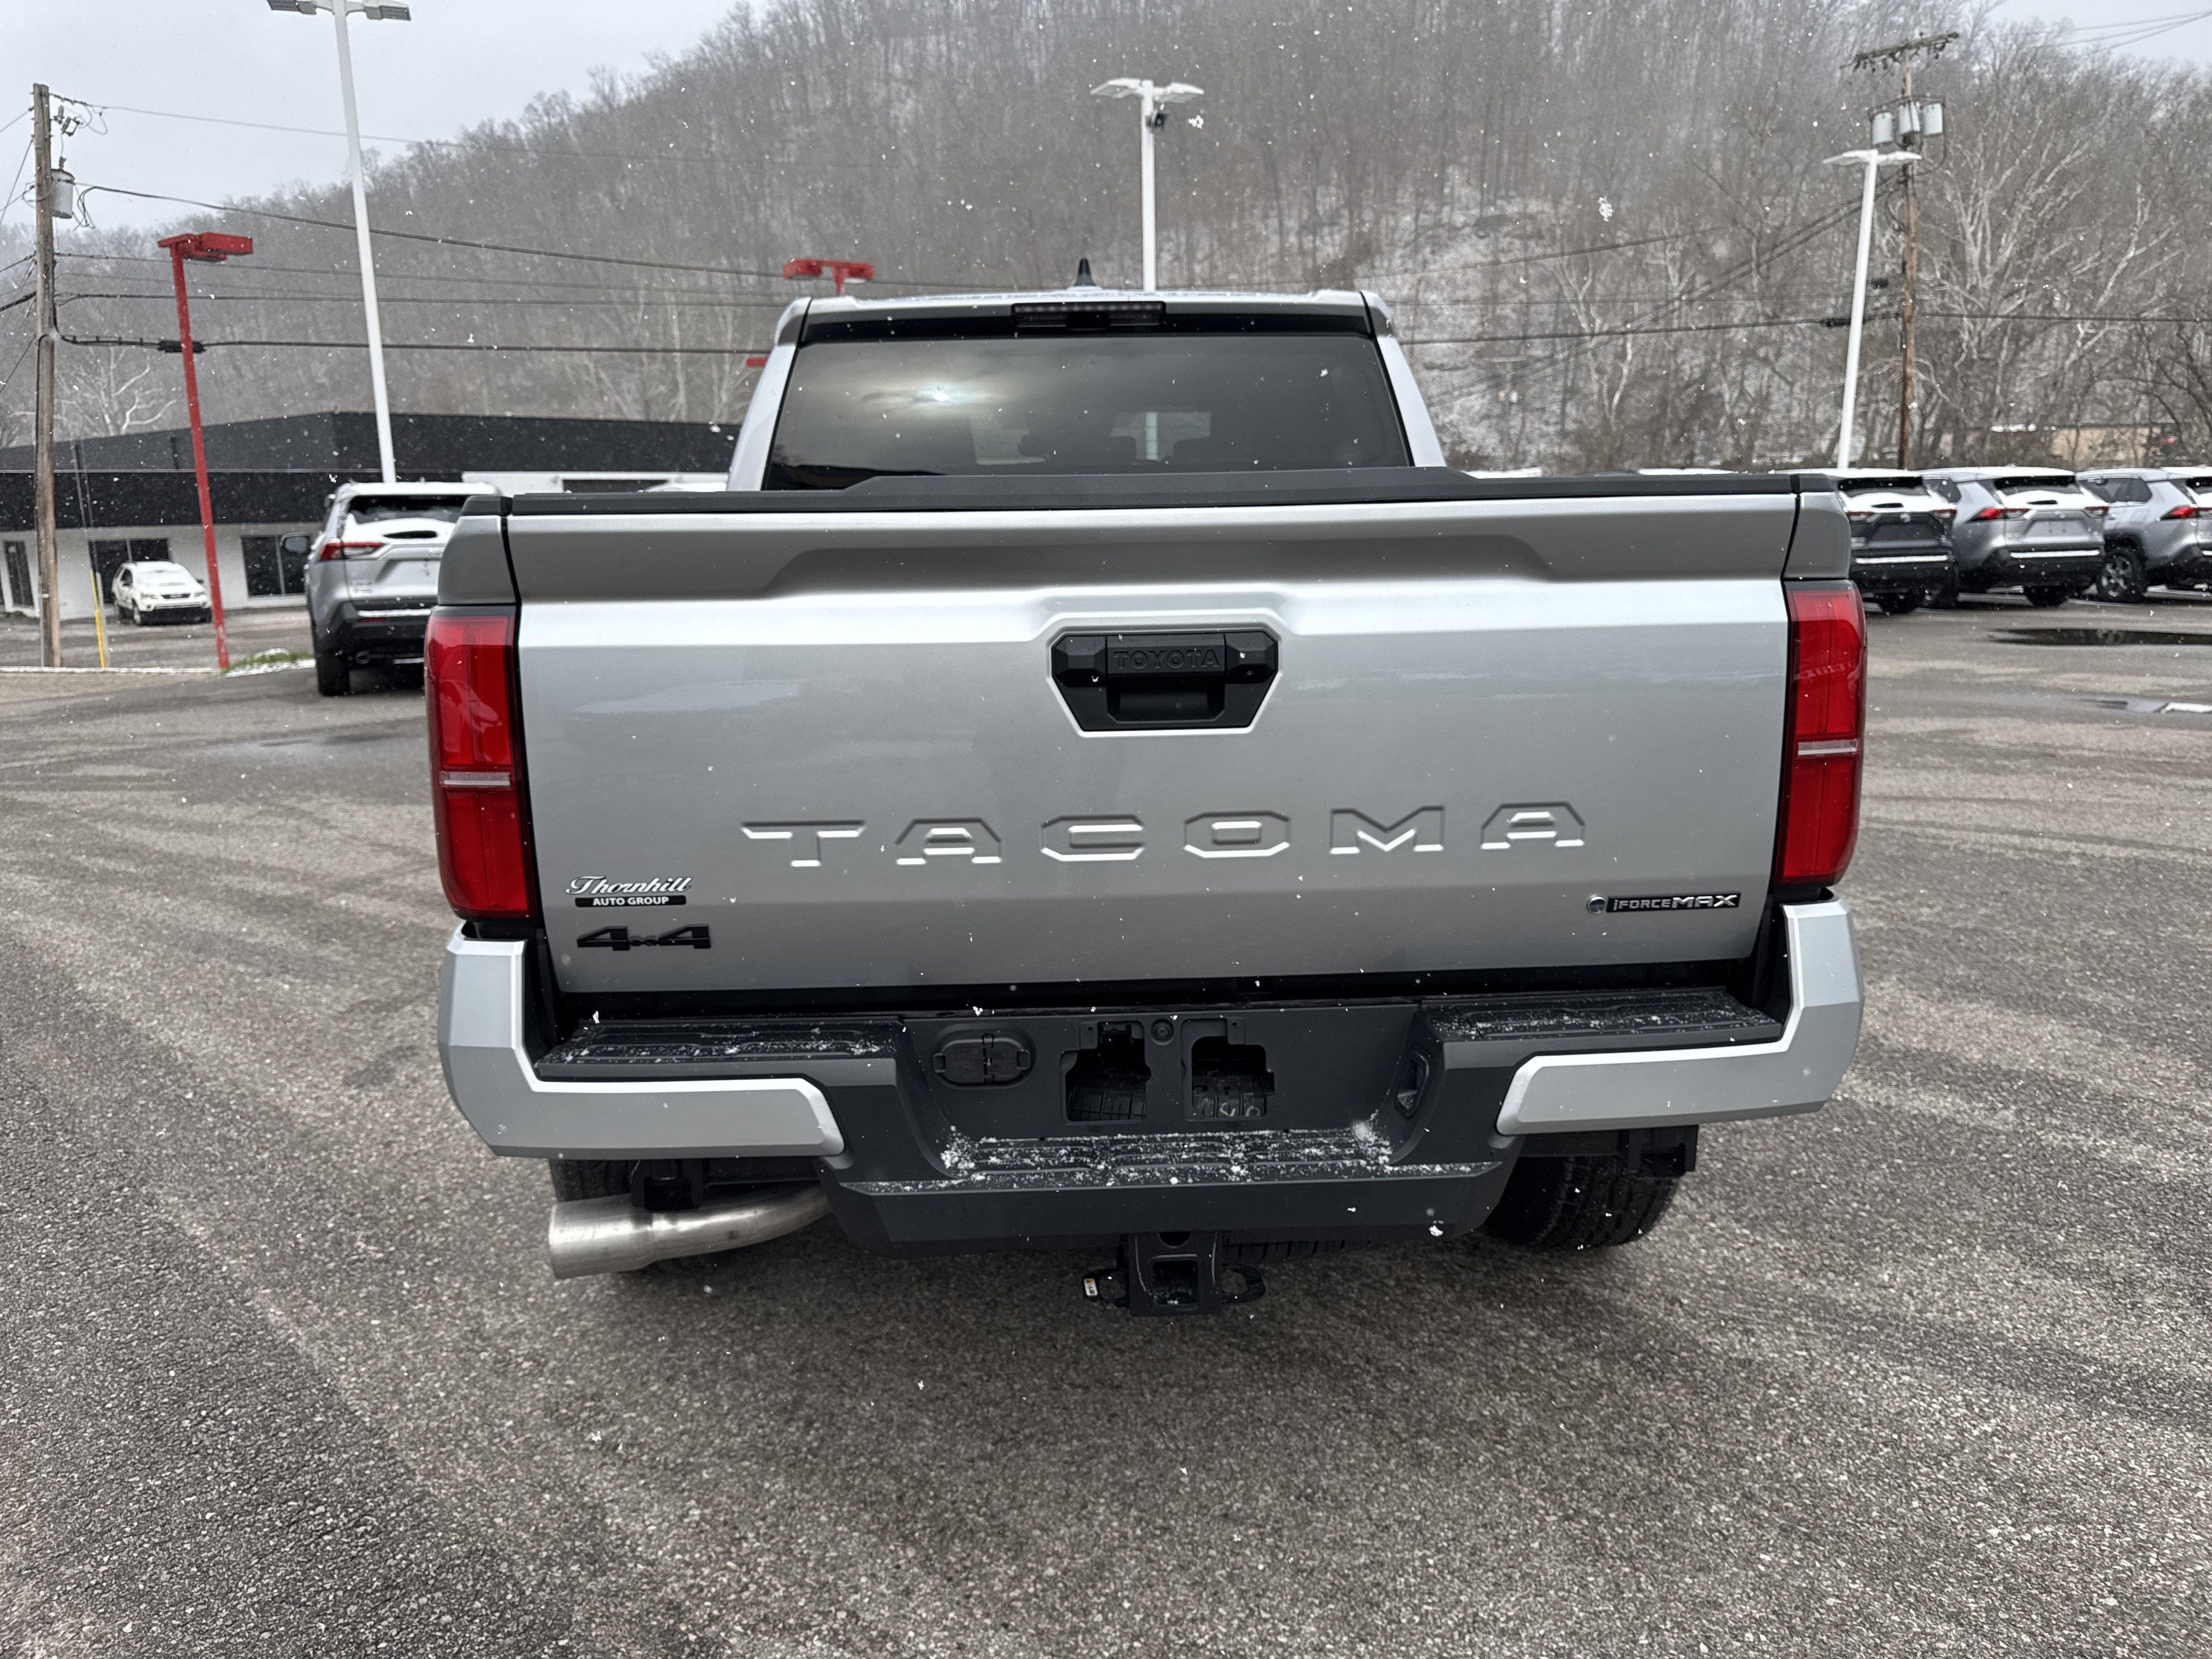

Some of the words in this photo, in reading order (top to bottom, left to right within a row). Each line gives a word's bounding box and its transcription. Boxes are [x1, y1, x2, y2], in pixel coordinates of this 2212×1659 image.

[1113, 650, 1221, 670] TOYOTA
[742, 802, 1584, 867] TACOMA
[566, 875, 693, 895] Thornhill
[592, 897, 625, 906] AUTO
[627, 896, 669, 905] GROUP
